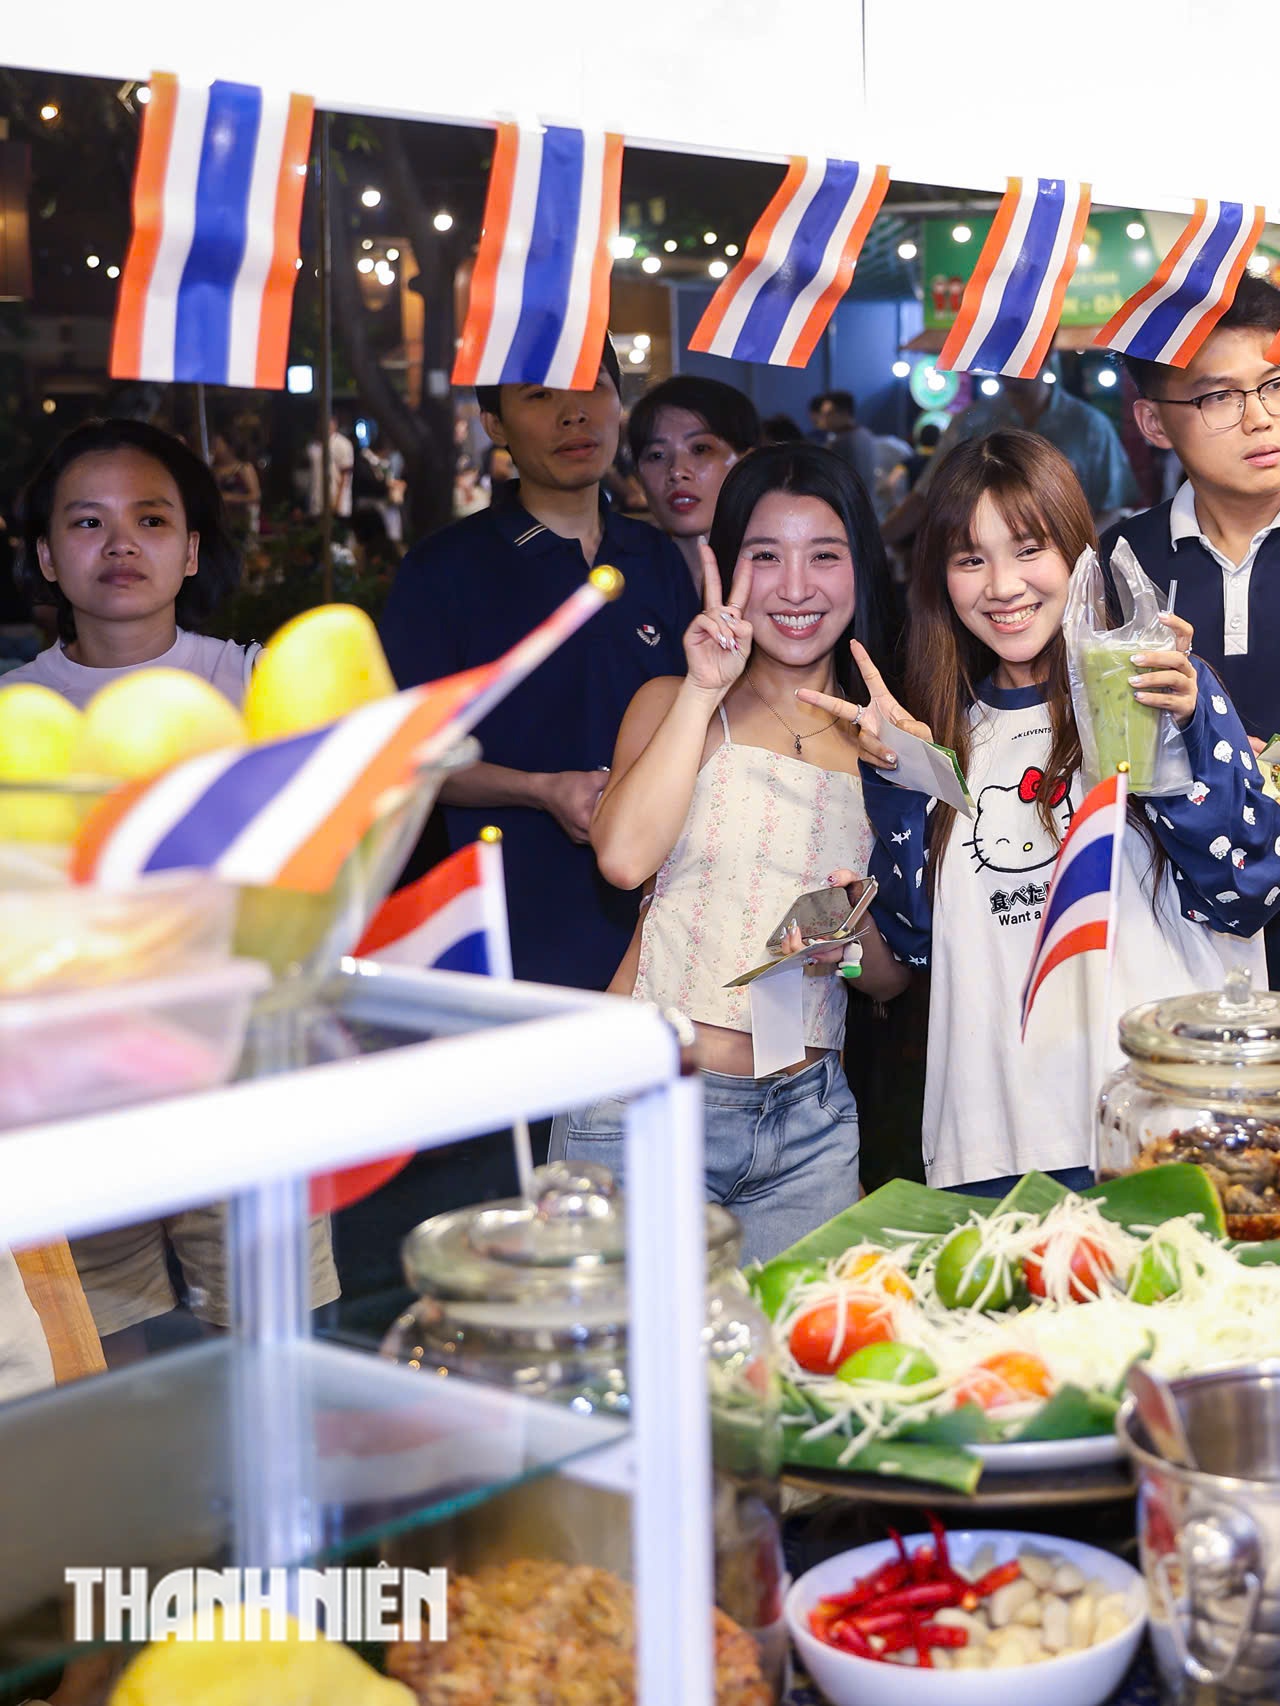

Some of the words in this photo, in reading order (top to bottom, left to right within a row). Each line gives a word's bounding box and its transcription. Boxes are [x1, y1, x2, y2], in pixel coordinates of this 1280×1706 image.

[1023, 727, 1052, 737] LEVENTS
[998, 911, 1031, 926] Want
[1034, 910, 1042, 920] a
